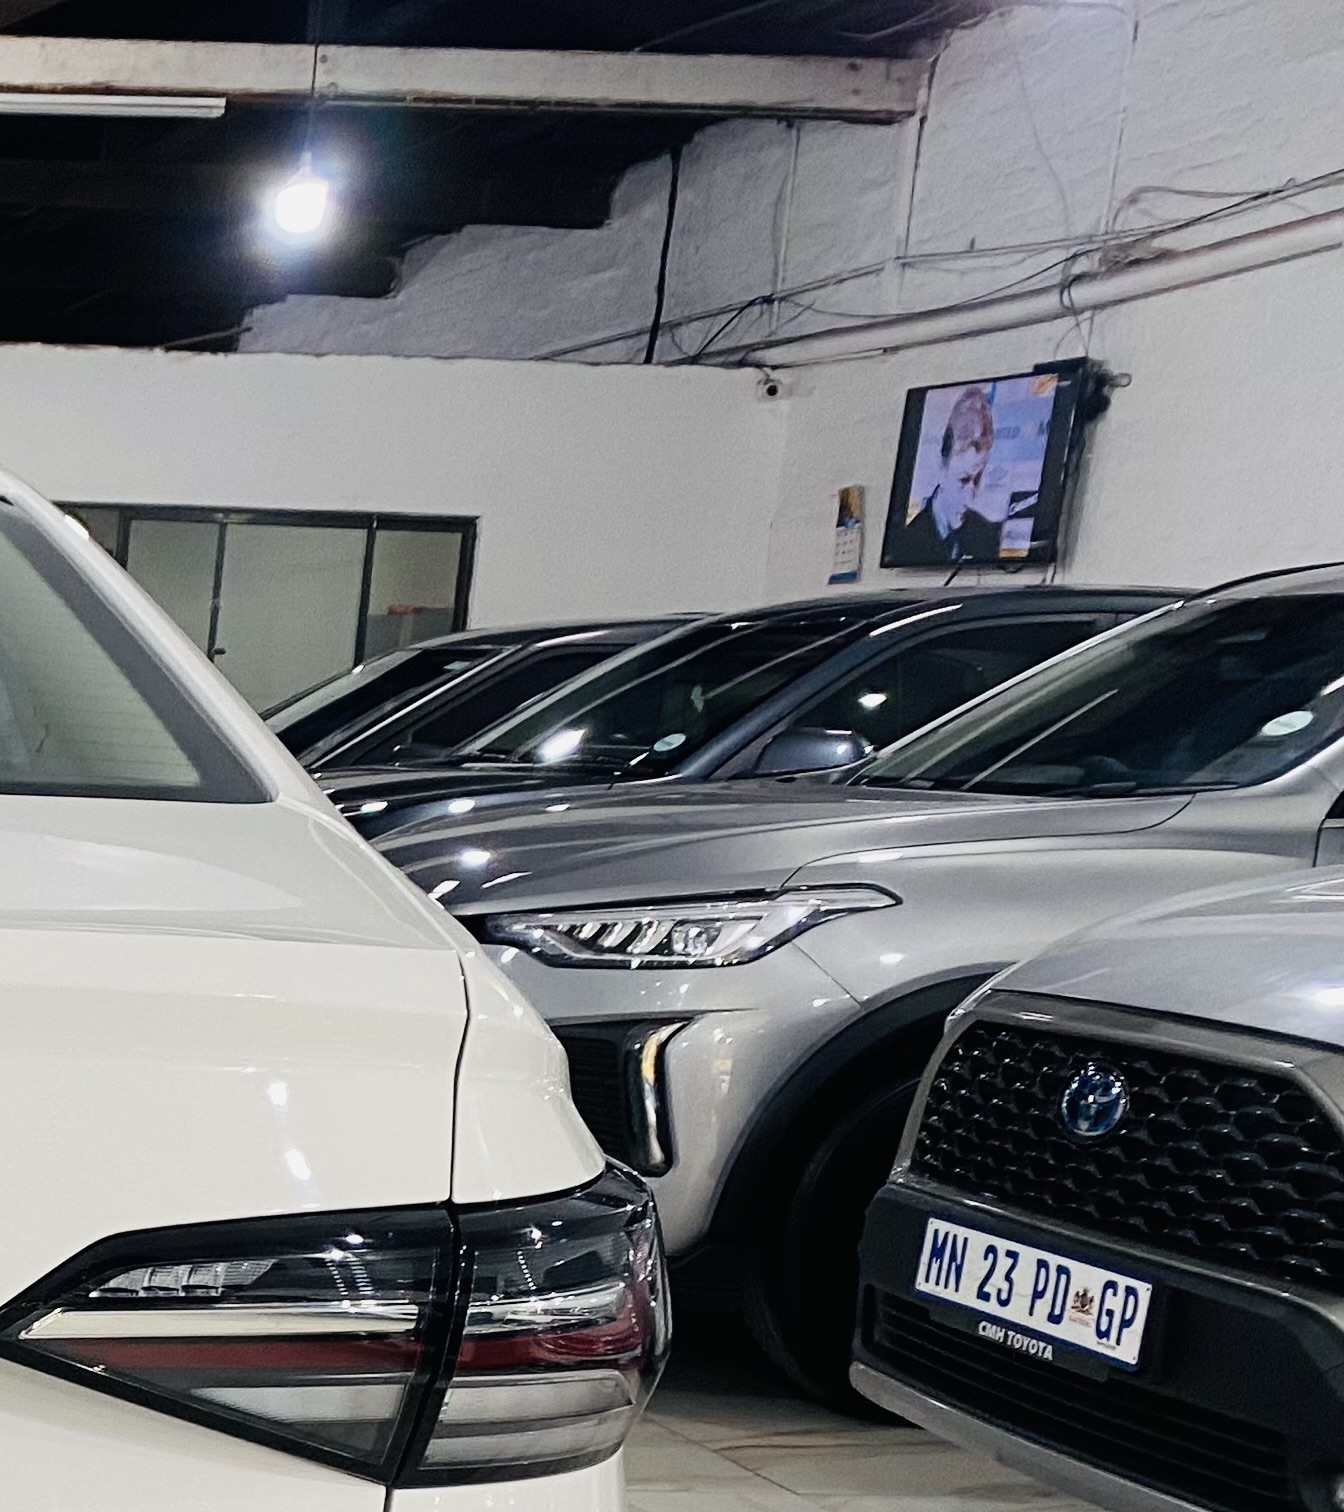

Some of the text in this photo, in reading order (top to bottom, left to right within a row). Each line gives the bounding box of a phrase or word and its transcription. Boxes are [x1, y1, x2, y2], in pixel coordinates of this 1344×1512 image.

[924, 1228, 1139, 1346] MN 23 PD GP
[978, 1320, 1053, 1361] CMH TOYOTA
